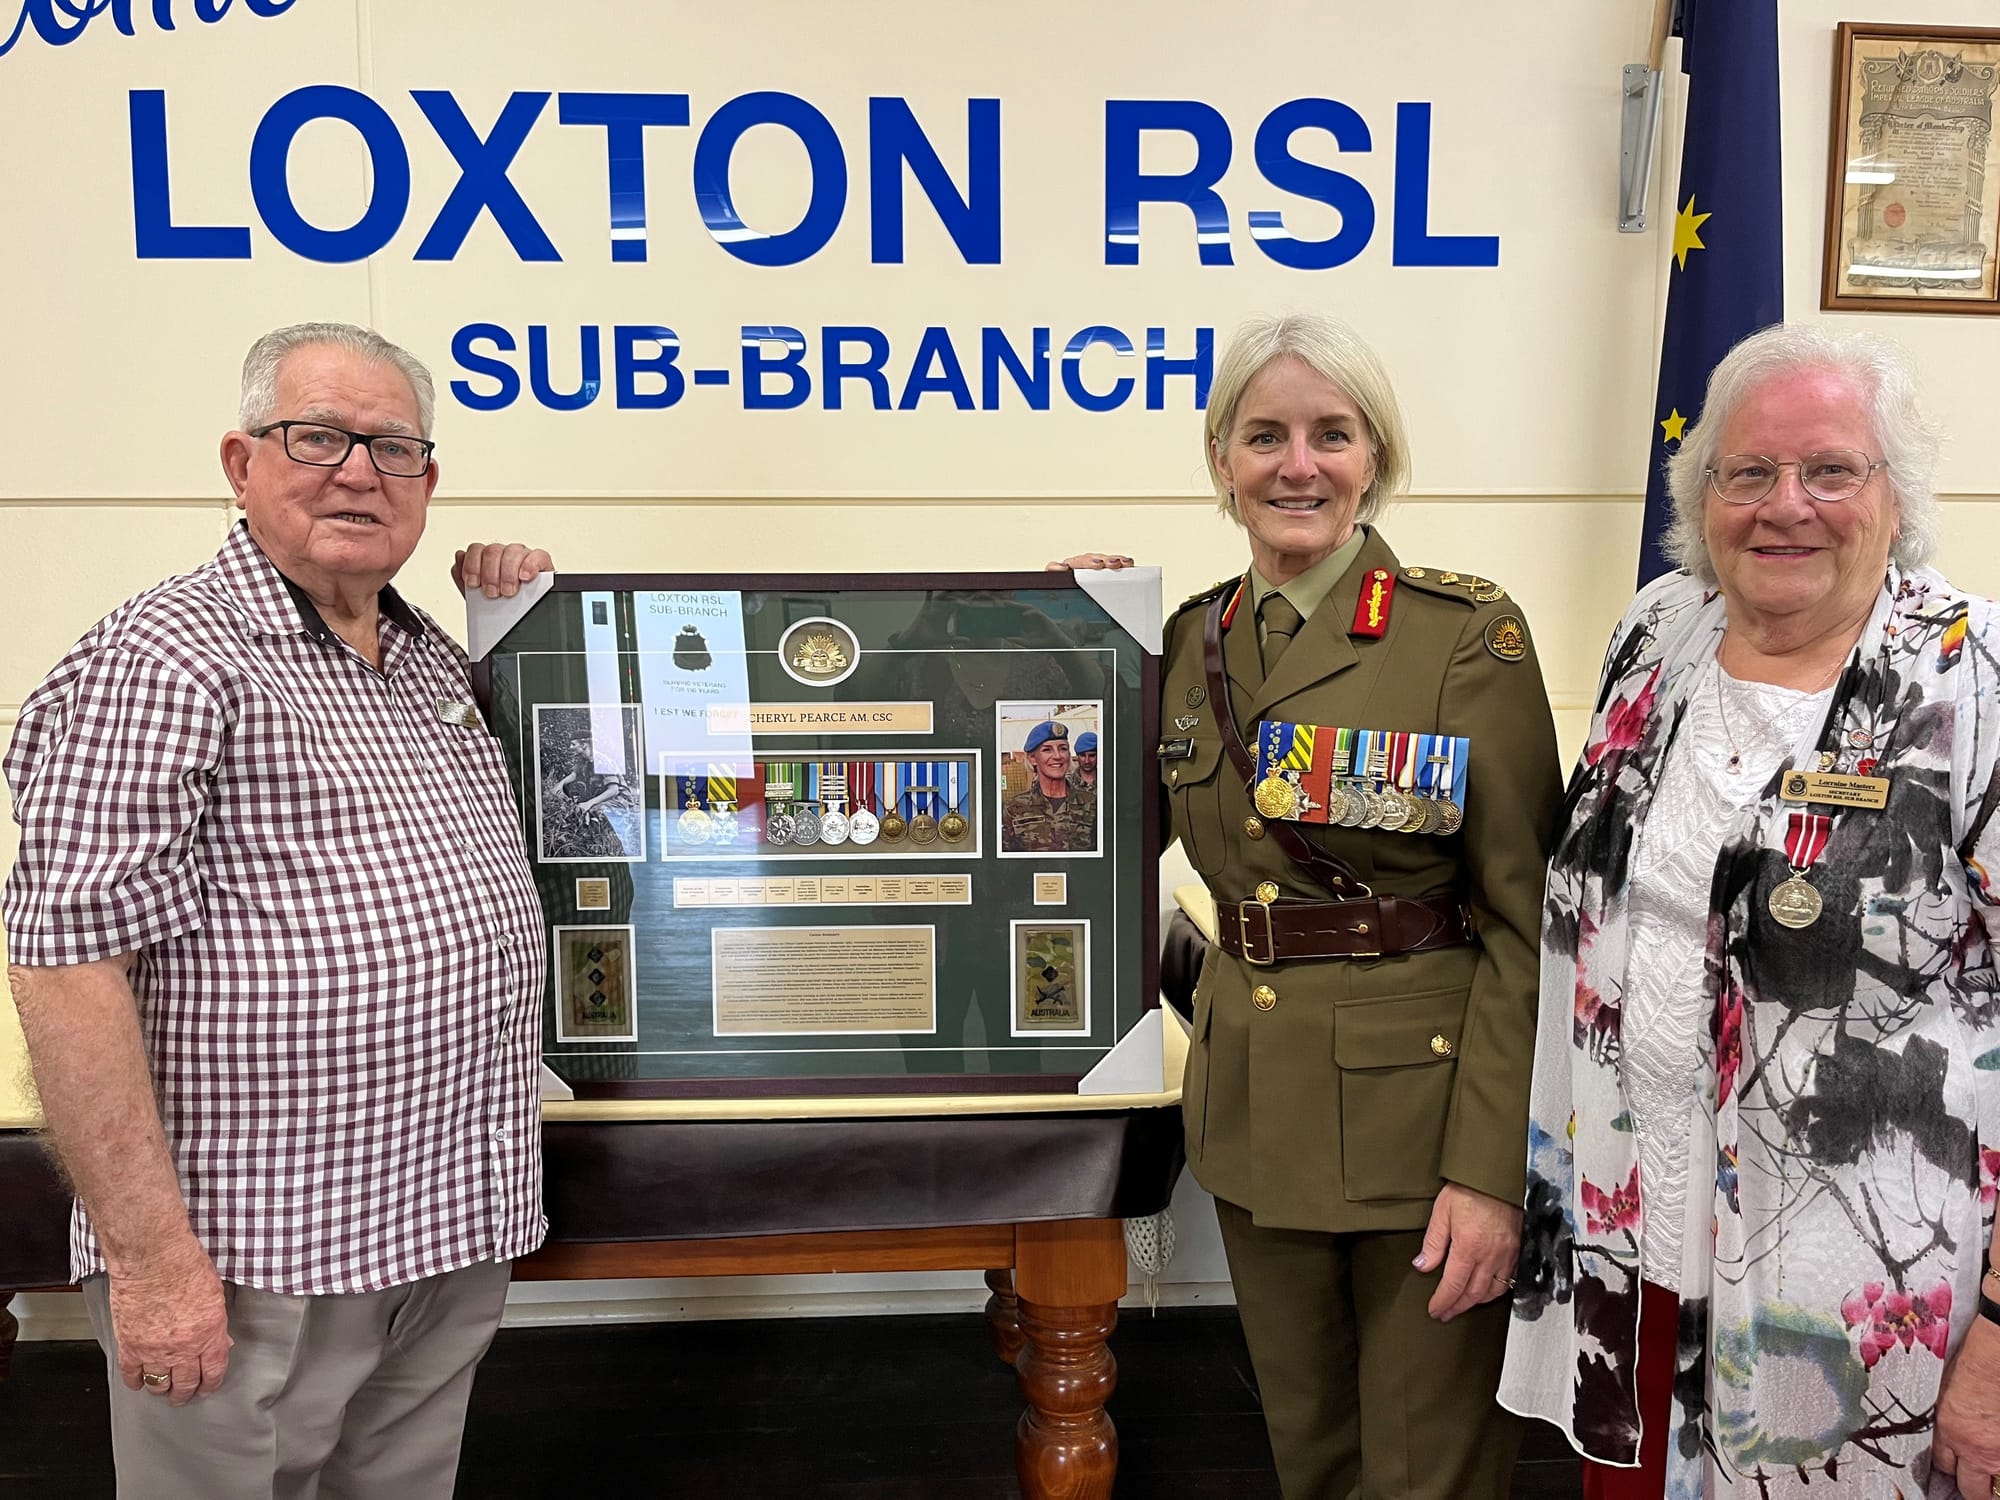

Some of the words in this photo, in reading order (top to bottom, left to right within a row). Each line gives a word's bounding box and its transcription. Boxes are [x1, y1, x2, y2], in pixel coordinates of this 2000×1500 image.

[128, 85, 1001, 266] LOXTON
[1104, 97, 1500, 271] RSL
[450, 323, 1215, 411] SUB-BRANCH
[651, 593, 698, 604] LOXTON
[702, 595, 724, 605] RSL
[649, 604, 728, 617] SUB-BRANCH
[750, 713, 796, 723] CHERYL
[800, 713, 847, 723] PEARCE
[872, 712, 893, 722] CSC
[1030, 1008, 1071, 1017] AUSTRALIA
